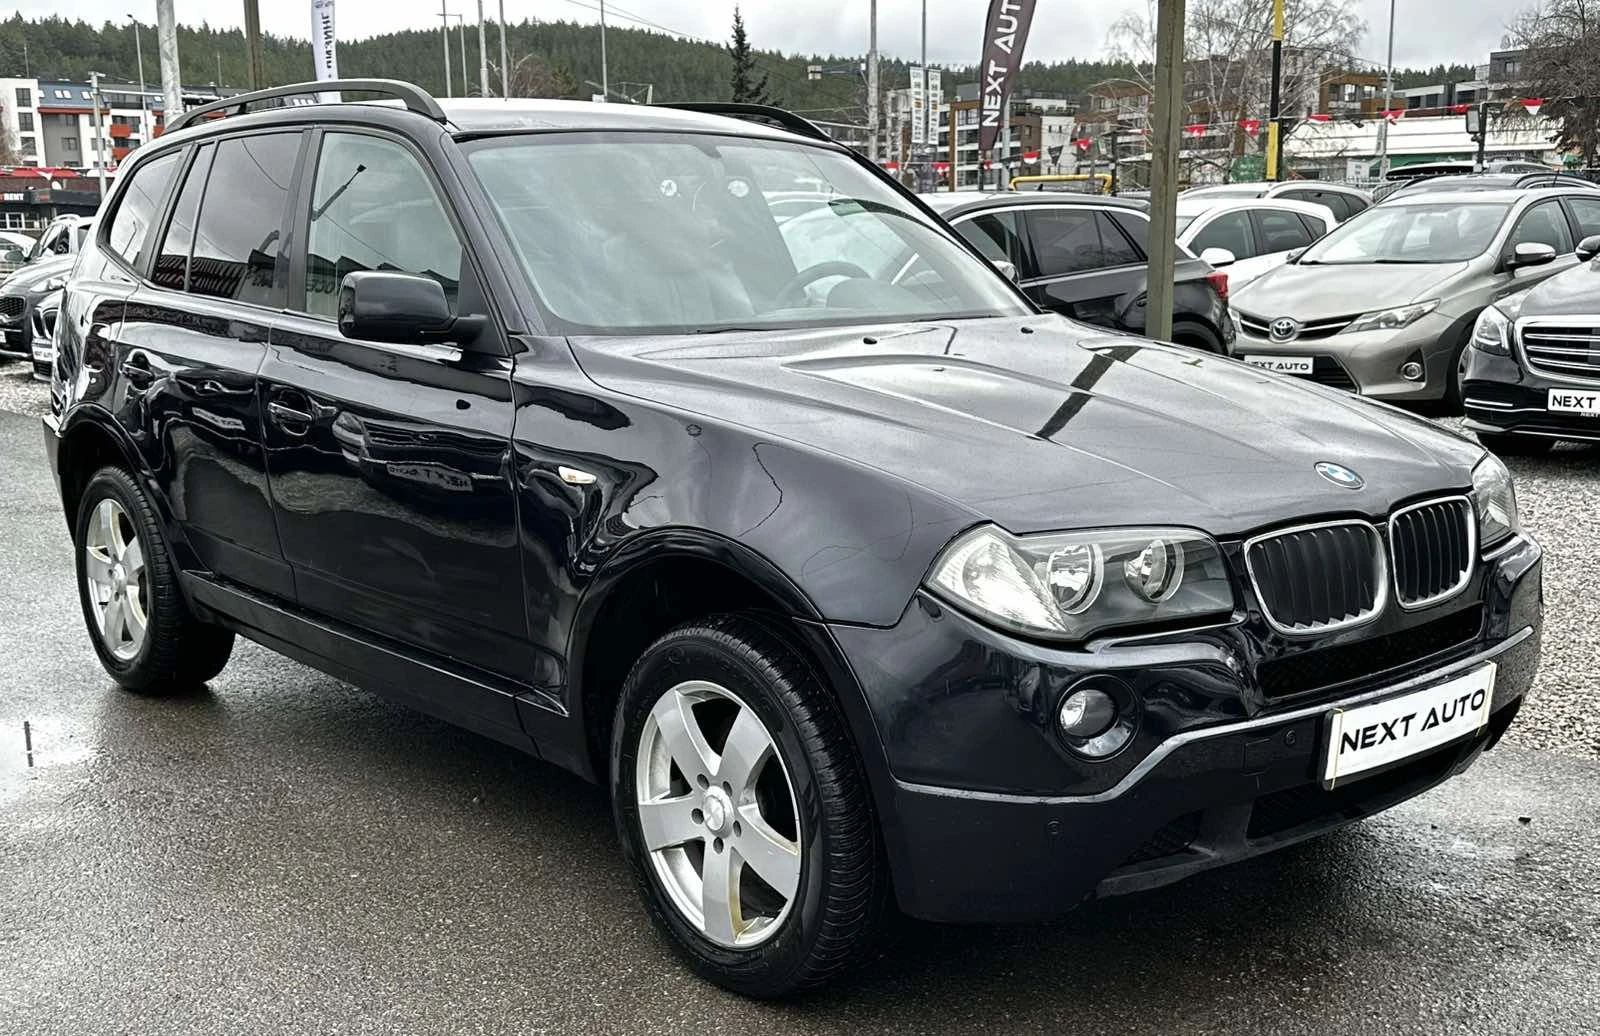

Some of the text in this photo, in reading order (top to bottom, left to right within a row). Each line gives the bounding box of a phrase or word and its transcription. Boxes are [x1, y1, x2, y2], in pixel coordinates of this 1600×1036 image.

[982, 0, 1021, 127] NEXT AUT
[1275, 362, 1310, 371] AUTO
[1552, 395, 1597, 409] NEXT
[1339, 688, 1486, 755] NEXT AUTO
